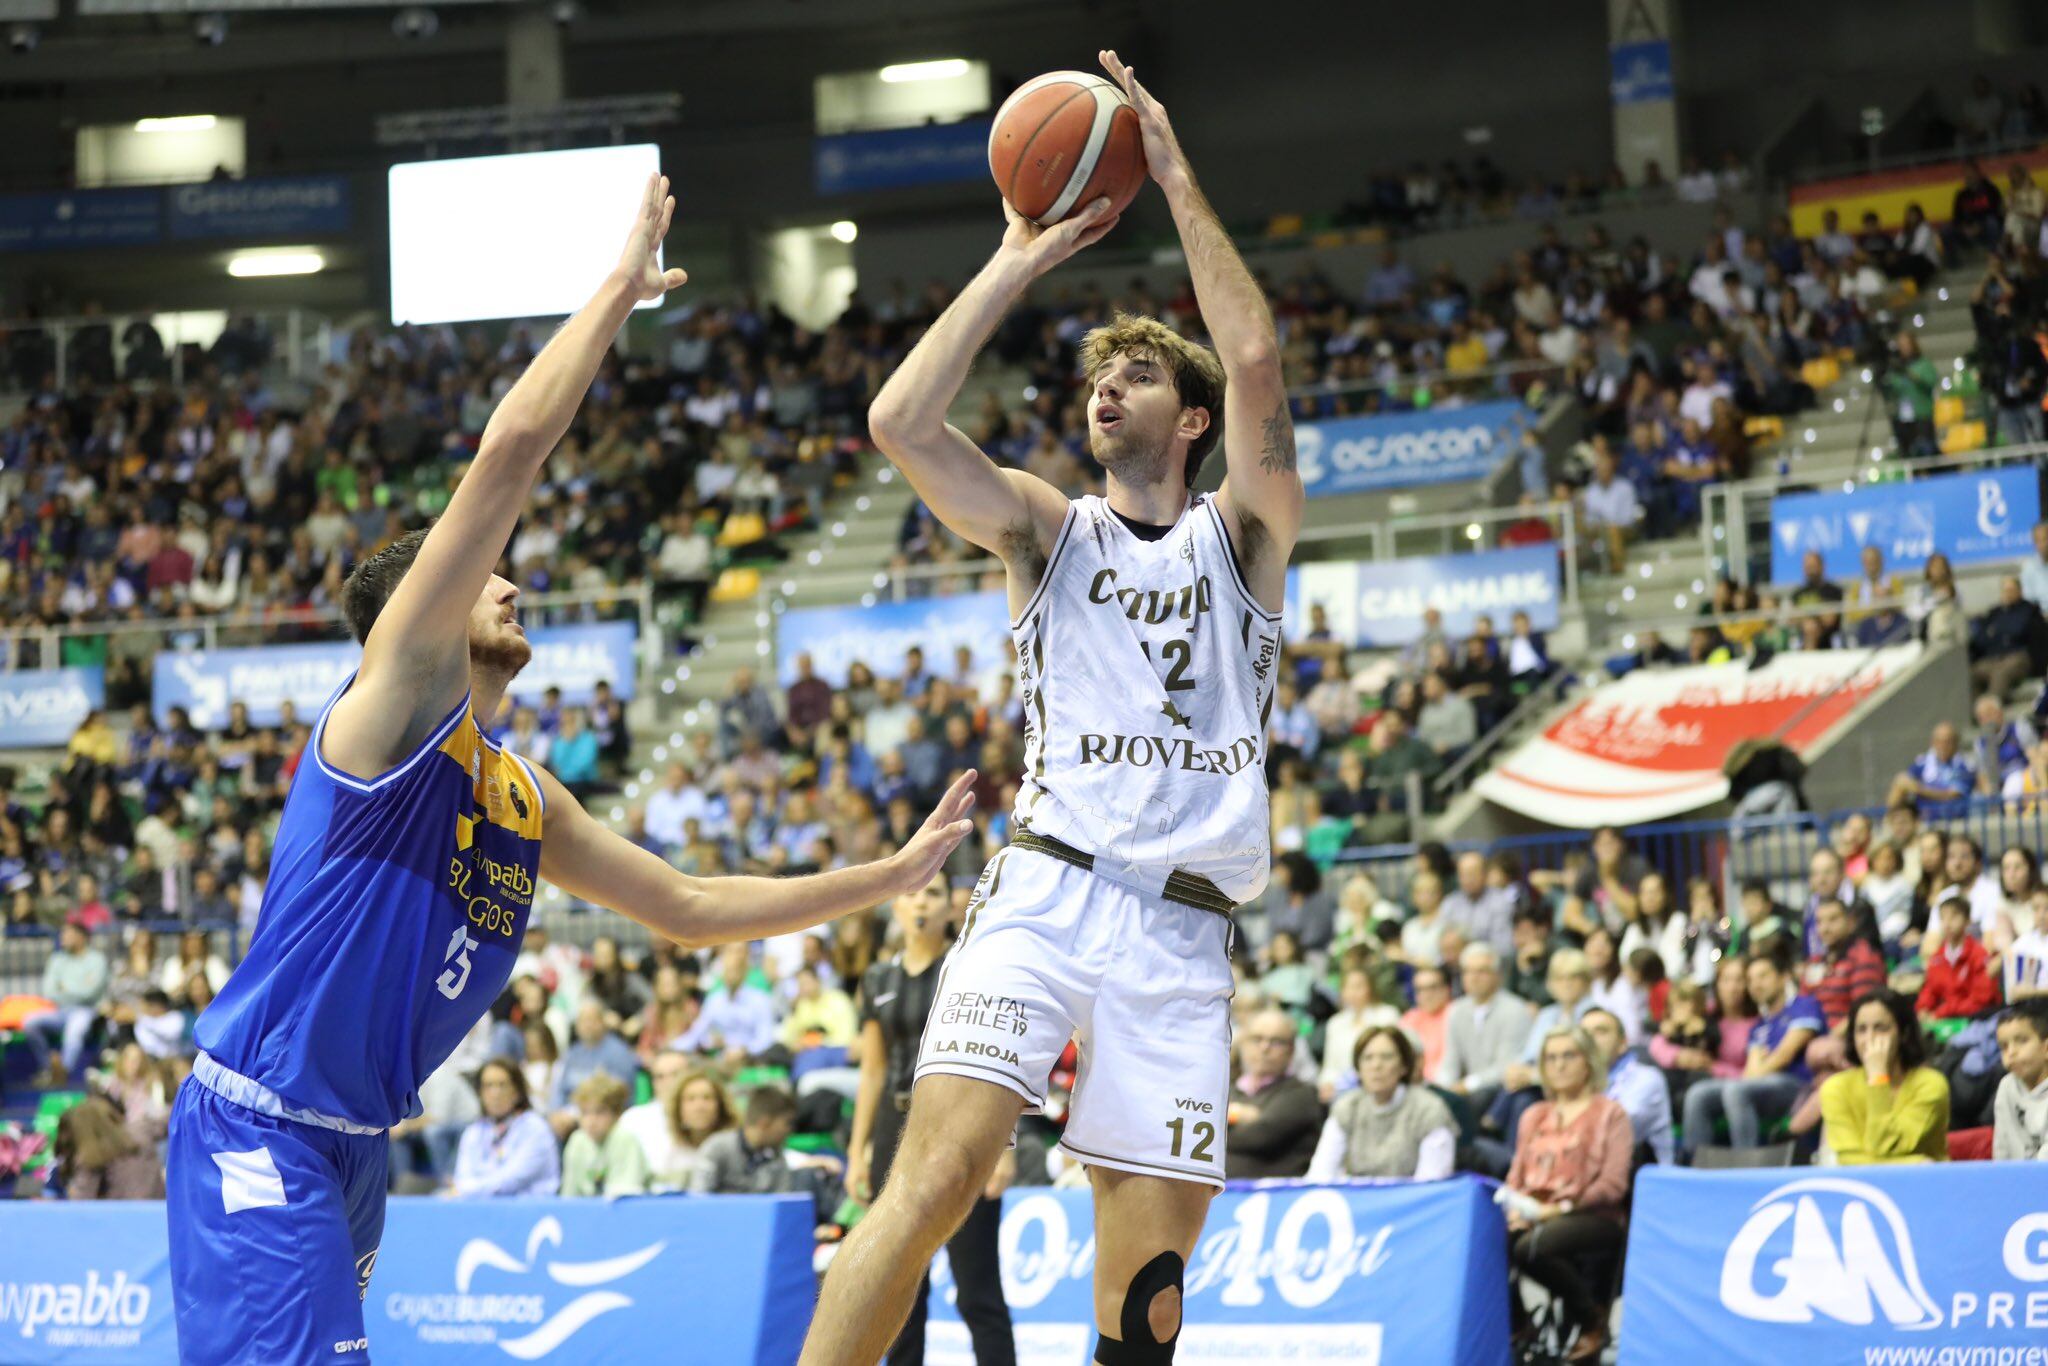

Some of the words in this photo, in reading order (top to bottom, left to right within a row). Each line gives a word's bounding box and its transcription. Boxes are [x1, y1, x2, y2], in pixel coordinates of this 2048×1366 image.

[1252, 634, 1275, 684] Real
[941, 1008, 1009, 1031] CHILE
[946, 992, 1029, 1021] DENTAL
[964, 1041, 1019, 1066] RIOJA
[1175, 1097, 1213, 1113] vive
[1166, 1117, 1215, 1162] 12
[1220, 1189, 1355, 1308] 10
